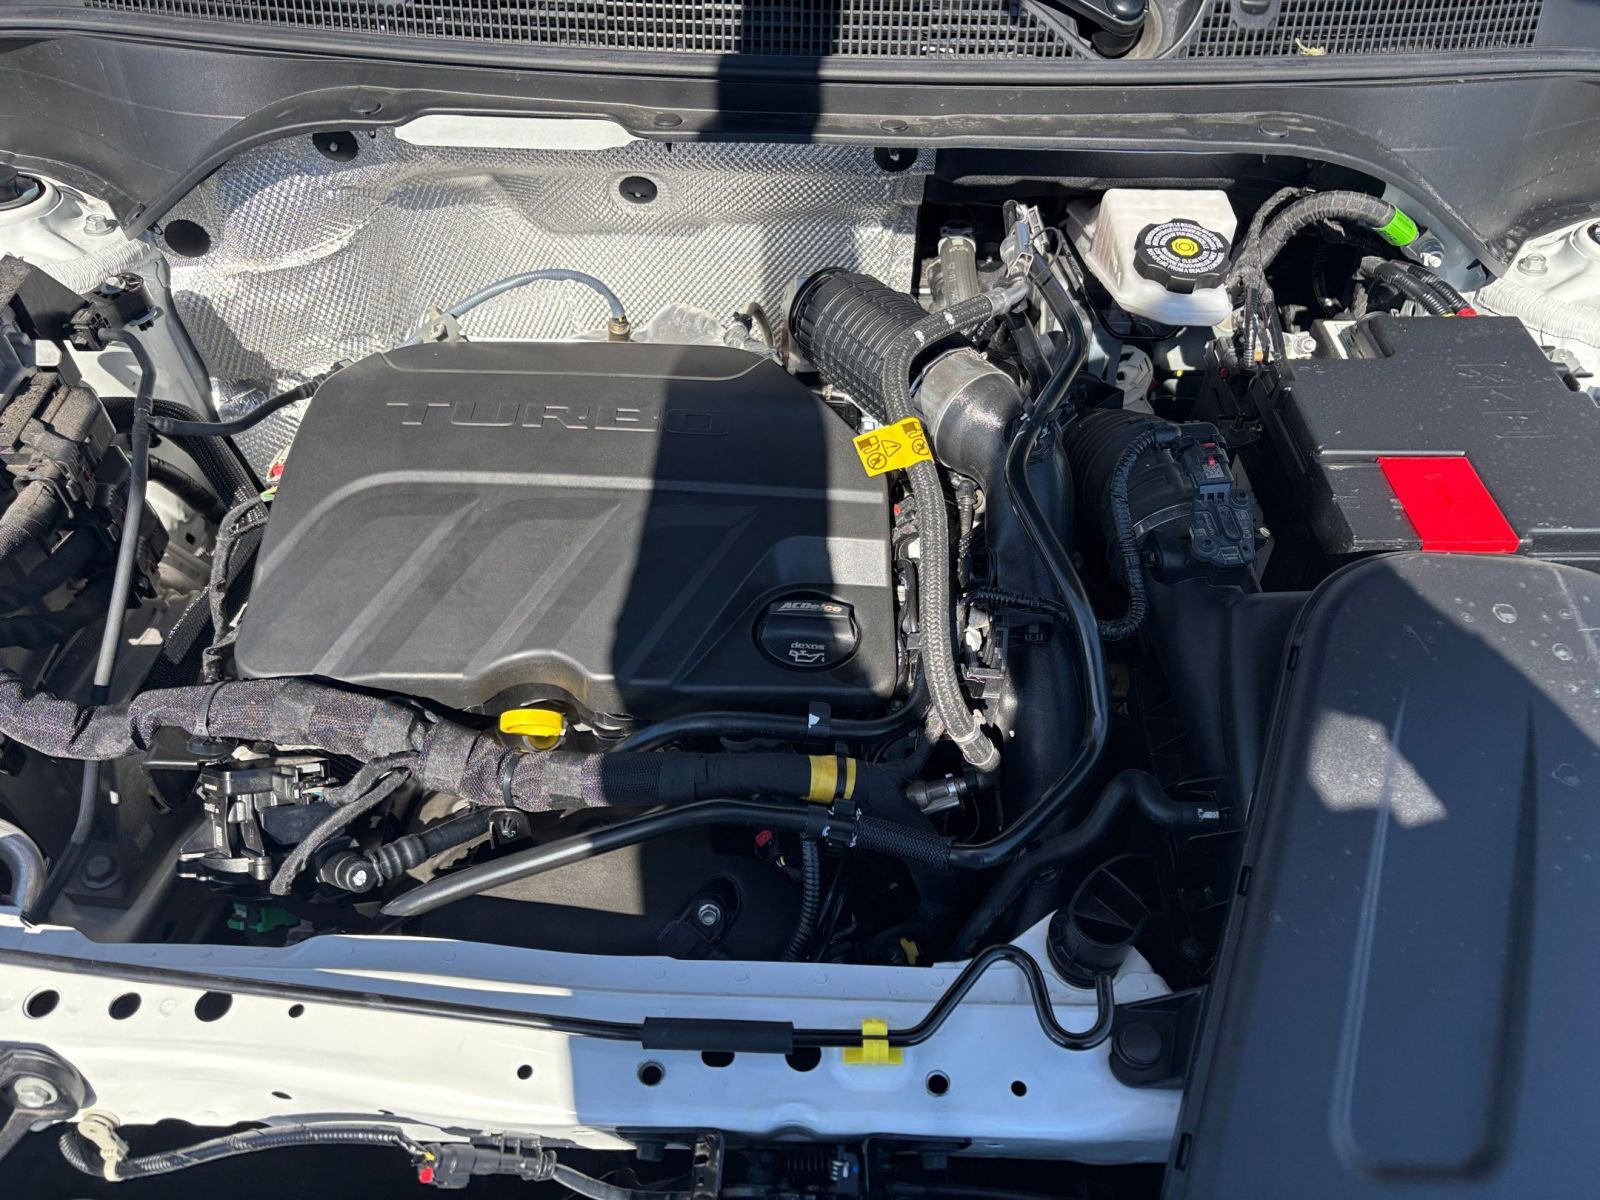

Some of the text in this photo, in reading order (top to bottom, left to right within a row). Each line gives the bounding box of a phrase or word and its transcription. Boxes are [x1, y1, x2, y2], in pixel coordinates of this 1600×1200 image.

[385, 400, 734, 436] TURBO
[780, 602, 843, 612] ACDelco
[790, 641, 825, 650] dexos
